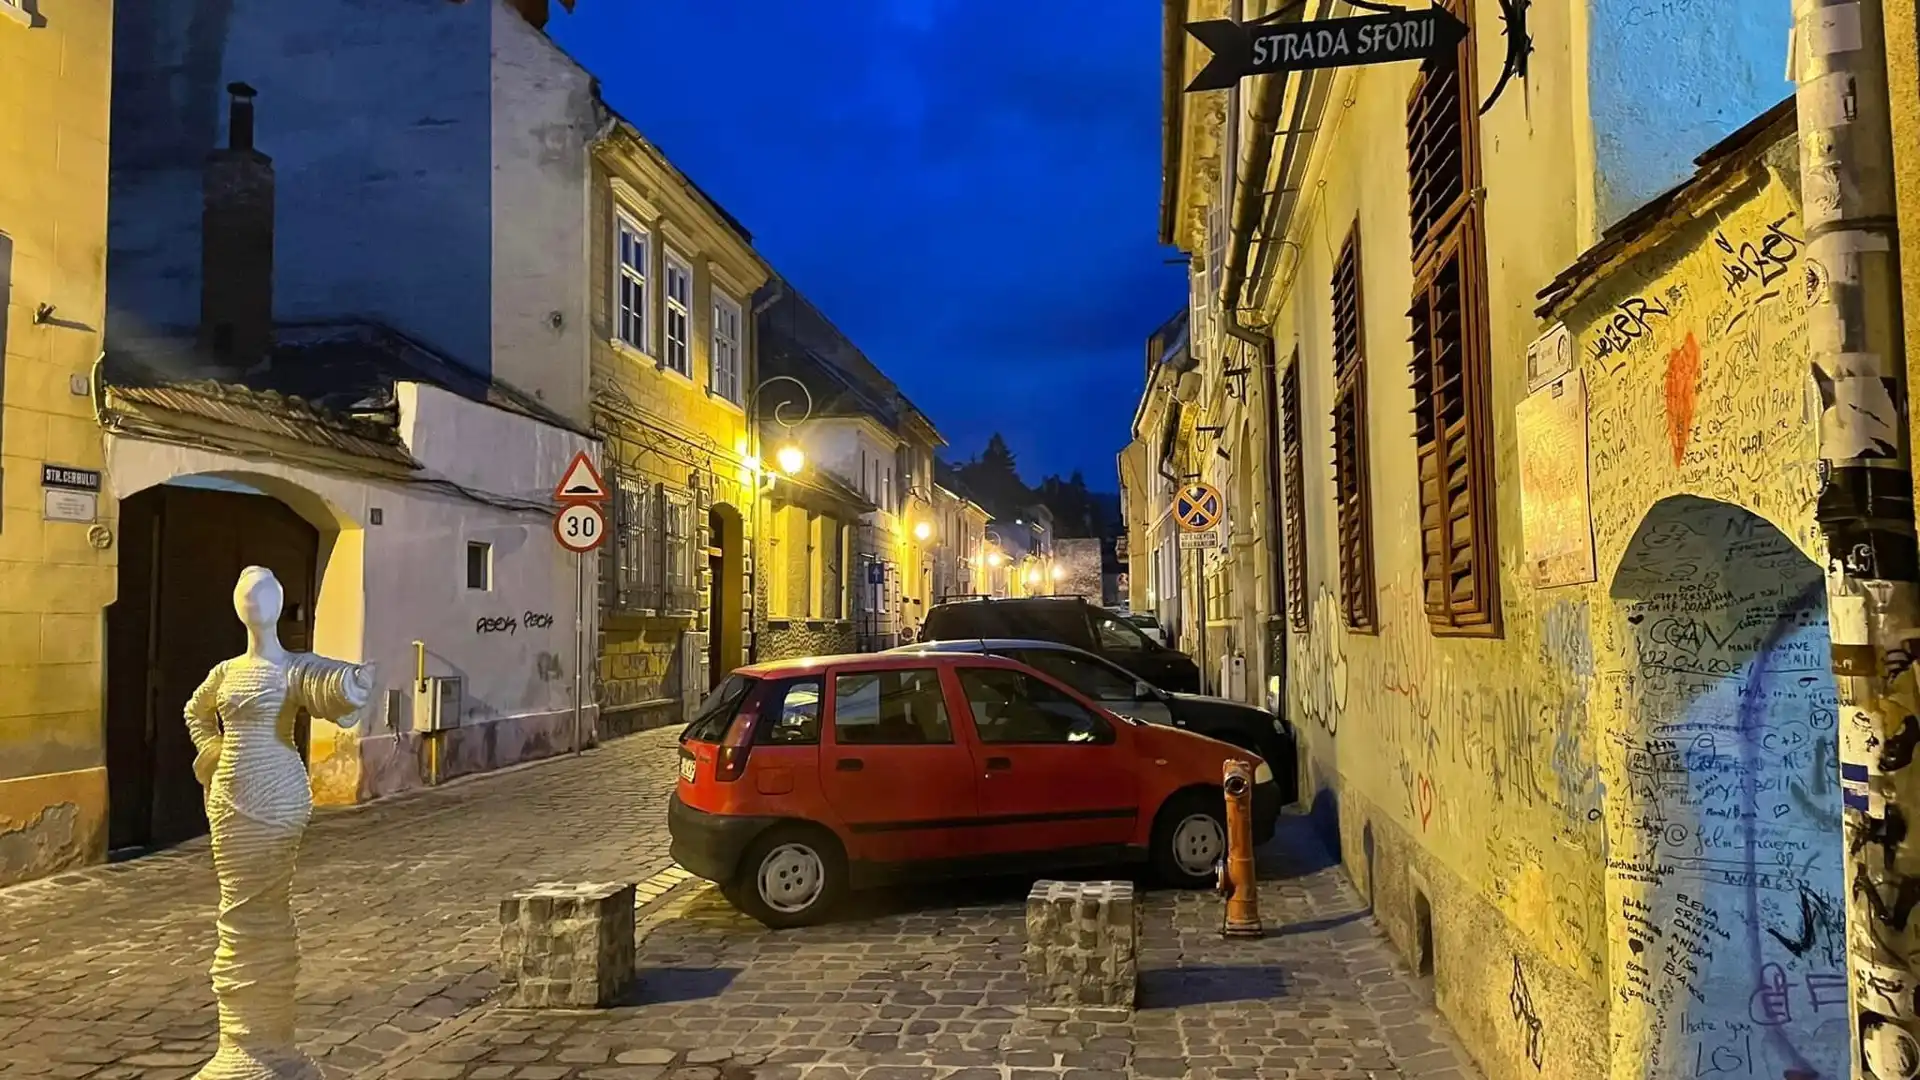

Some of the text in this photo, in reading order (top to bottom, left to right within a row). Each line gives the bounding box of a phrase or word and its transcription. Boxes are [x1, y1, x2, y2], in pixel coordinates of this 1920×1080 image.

[1252, 19, 1435, 65] STRADA SFORII
[567, 516, 594, 537] 30
[1676, 893, 1719, 921] ELENA
